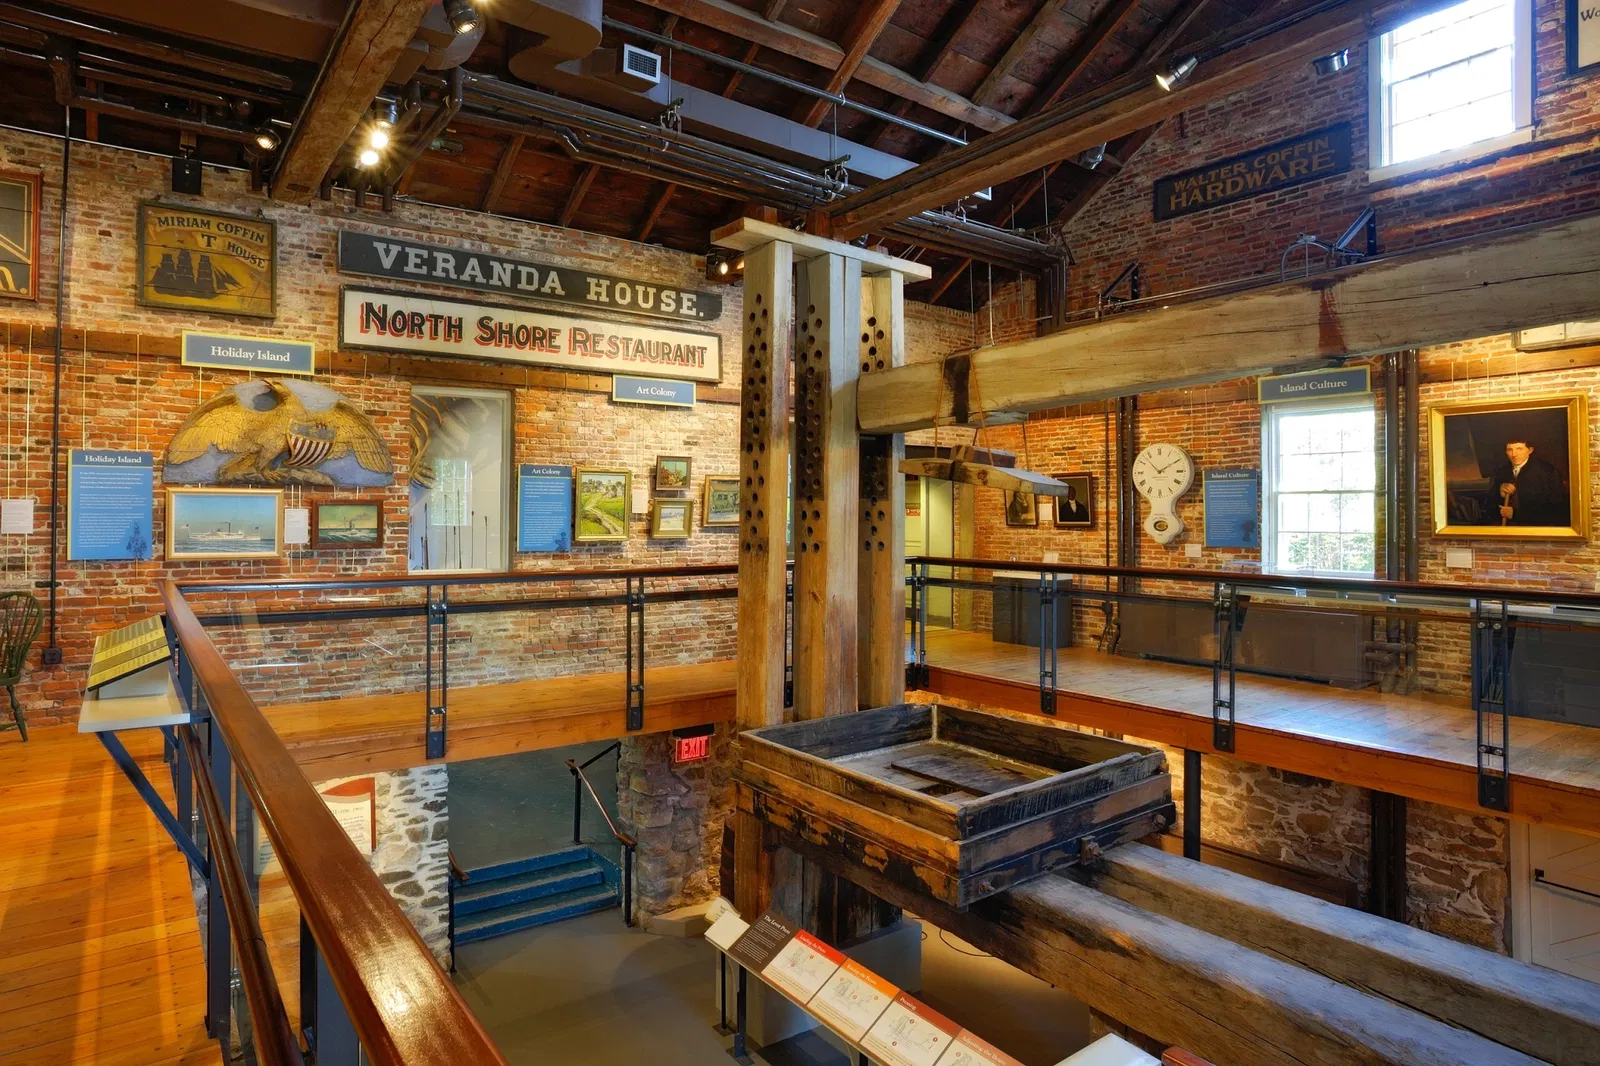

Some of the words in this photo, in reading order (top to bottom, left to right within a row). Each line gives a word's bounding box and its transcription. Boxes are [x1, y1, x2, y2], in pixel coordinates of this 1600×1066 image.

[1173, 162, 1249, 193] WALTER
[1253, 136, 1329, 169] COFFIN
[1170, 149, 1336, 210] HARDWARE
[157, 215, 211, 229] MIRIAM
[216, 222, 266, 244] COFFIN
[201, 233, 217, 248] T
[227, 240, 265, 269] HOUSE
[372, 241, 565, 296] VERANDA
[586, 276, 704, 317] HOUSE.
[210, 345, 255, 361] Holiday
[257, 349, 291, 362] Island
[636, 385, 650, 395] Art
[650, 386, 676, 398] Colony
[1279, 382, 1307, 393] Island
[1309, 378, 1347, 390] Culture
[85, 455, 116, 464] Holiday
[681, 736, 708, 759] EXIT
